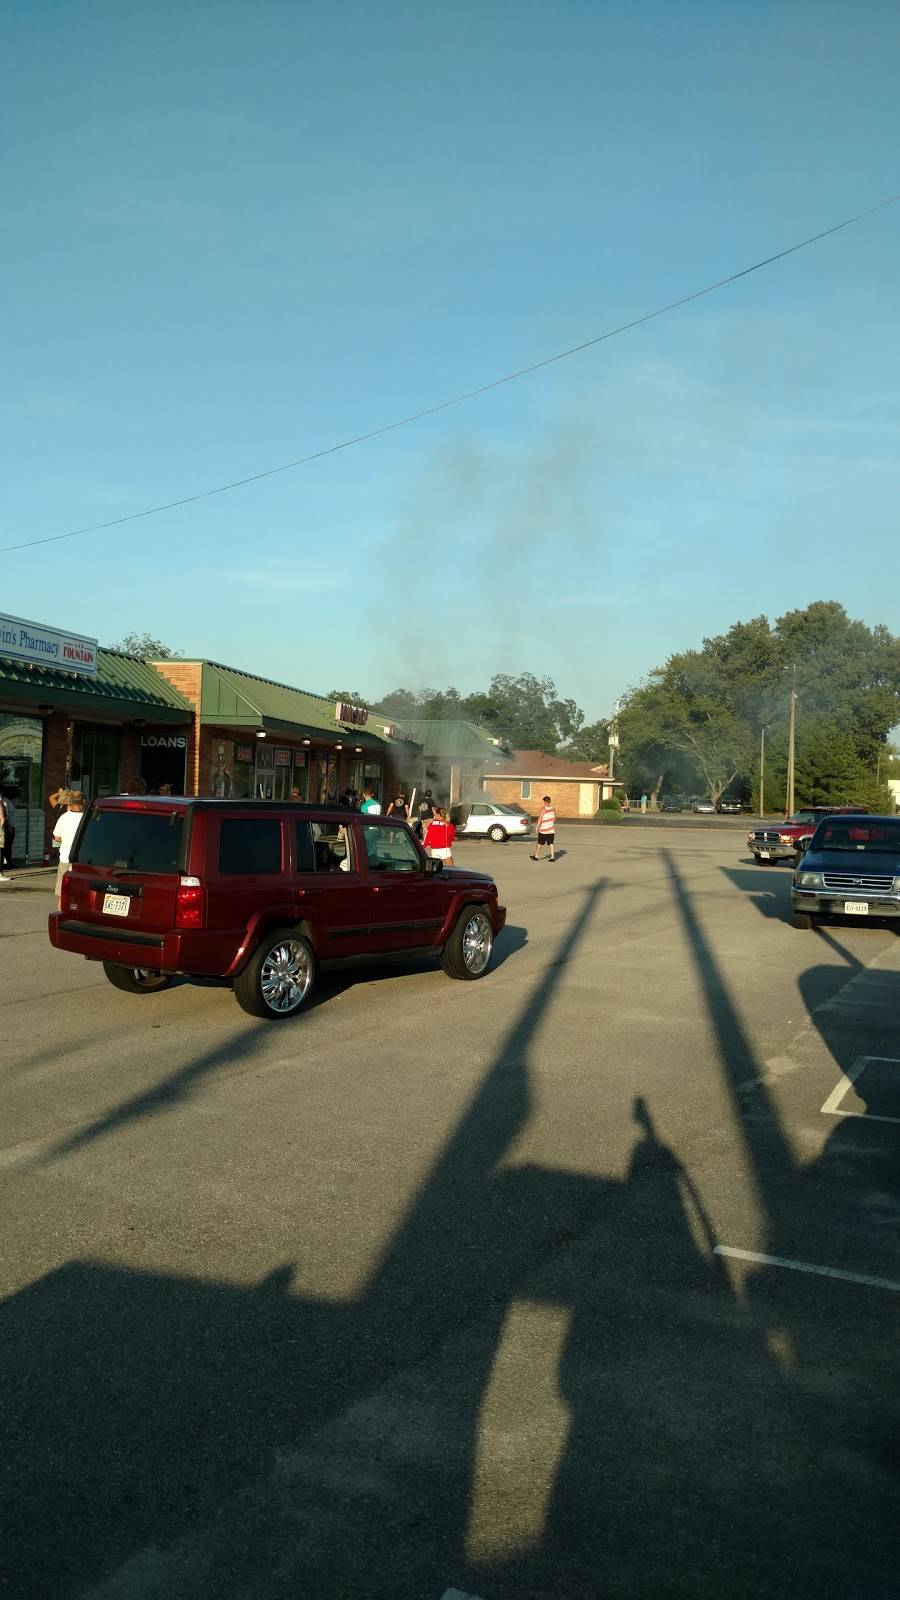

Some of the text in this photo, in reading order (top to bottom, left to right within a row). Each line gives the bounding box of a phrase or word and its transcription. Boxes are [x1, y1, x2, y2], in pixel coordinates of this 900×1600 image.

[20, 630, 60, 657] Pharmacy
[63, 646, 94, 663] FOUNTAIN
[141, 736, 186, 748] LOANS
